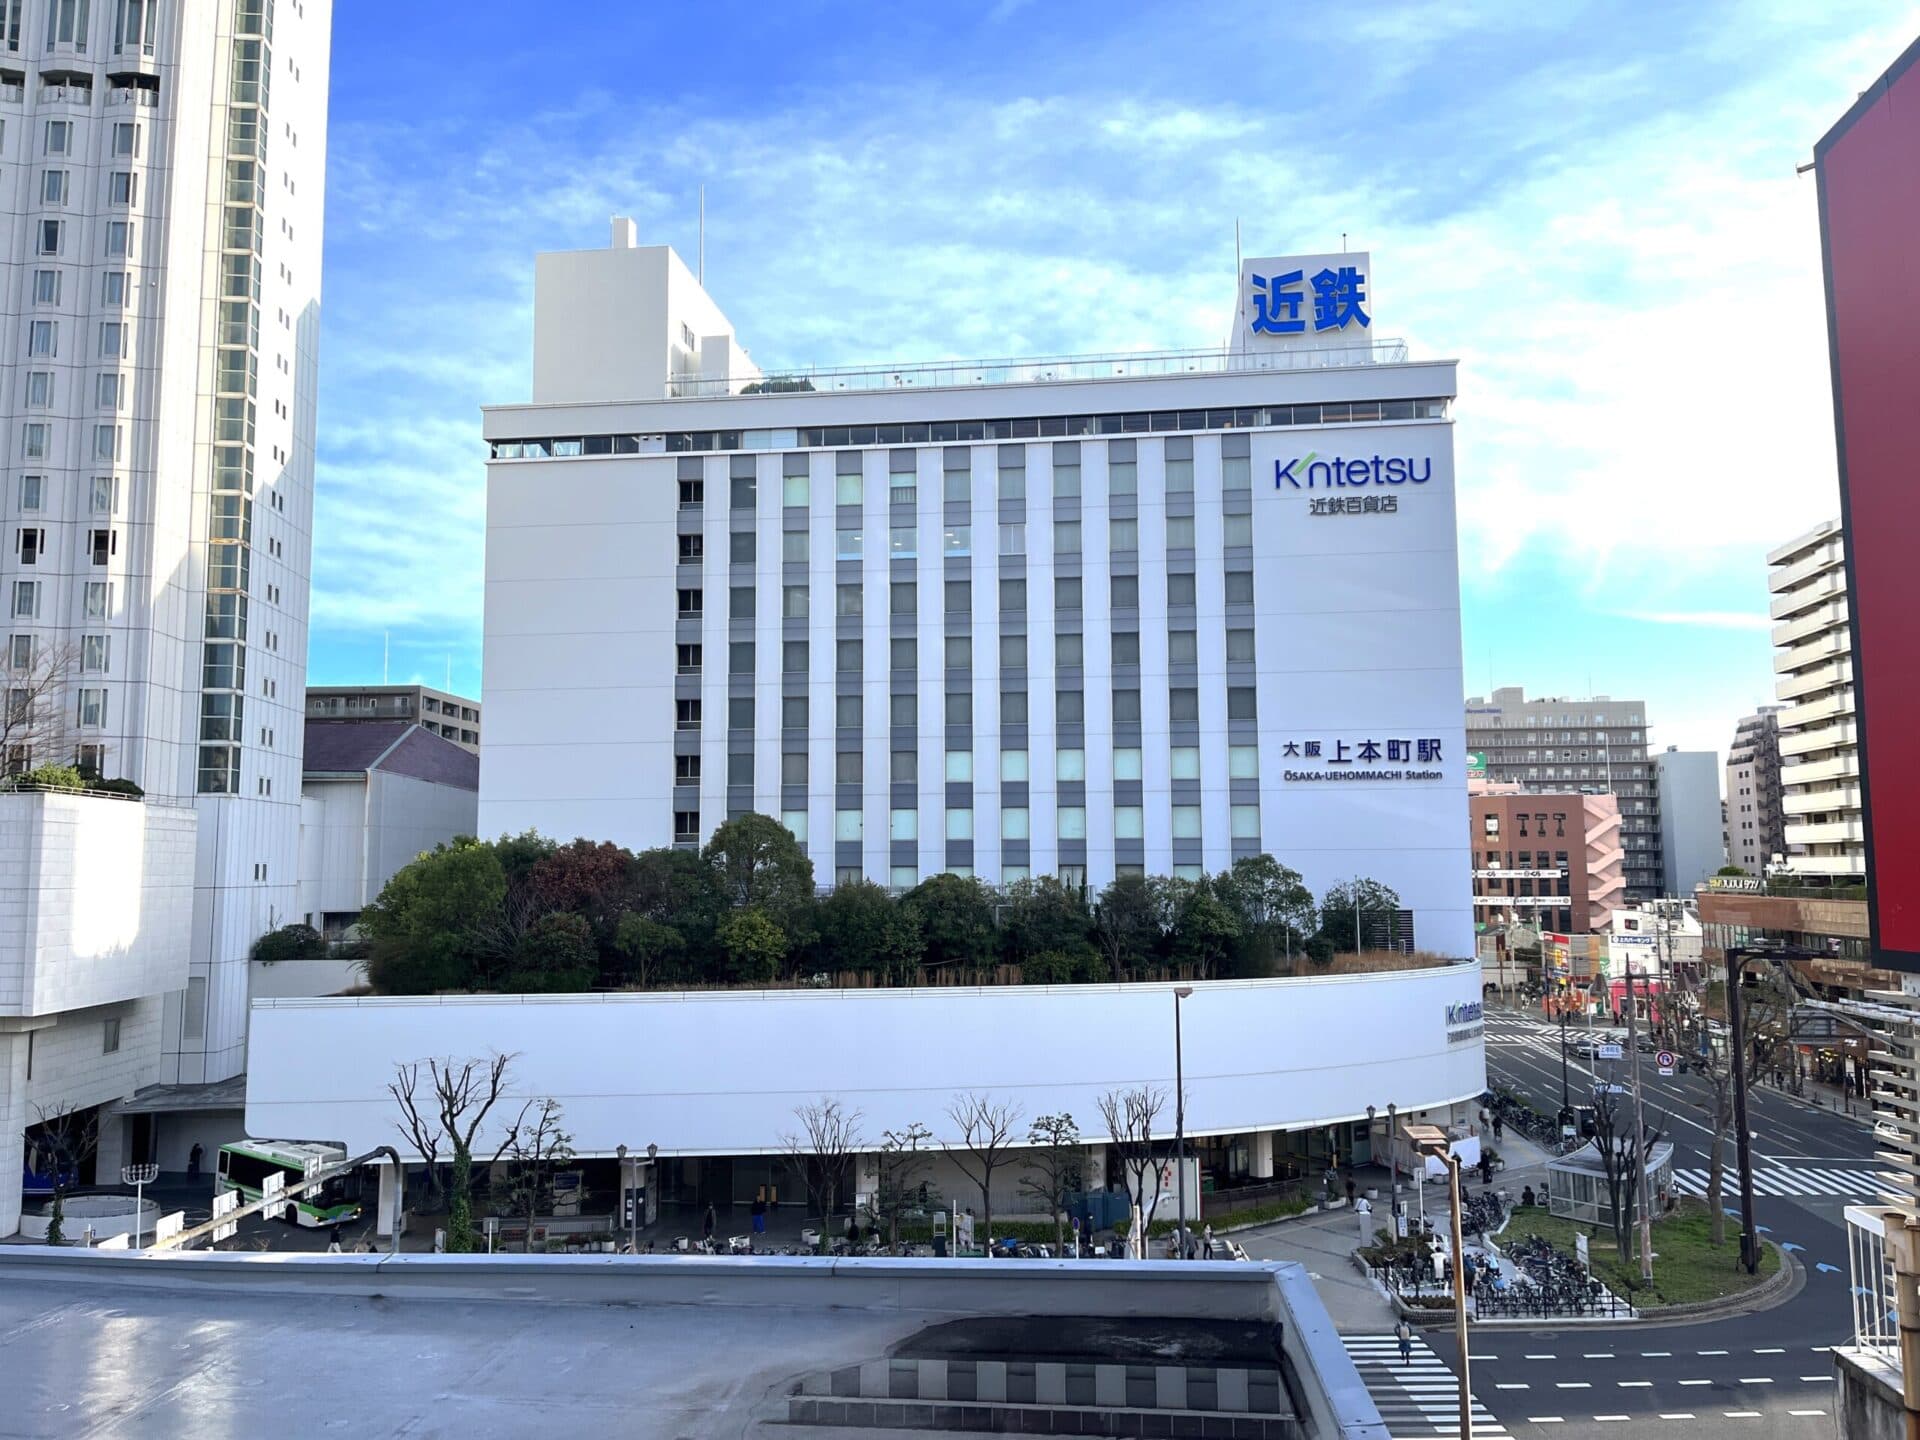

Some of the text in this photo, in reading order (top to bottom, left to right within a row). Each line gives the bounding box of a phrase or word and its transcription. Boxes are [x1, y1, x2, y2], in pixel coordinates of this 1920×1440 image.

[1251, 266, 1371, 335] 近鉄
[1275, 452, 1431, 489] Kintetsu
[1310, 495, 1398, 516] 近鉄百貨店
[1405, 769, 1443, 780] Station
